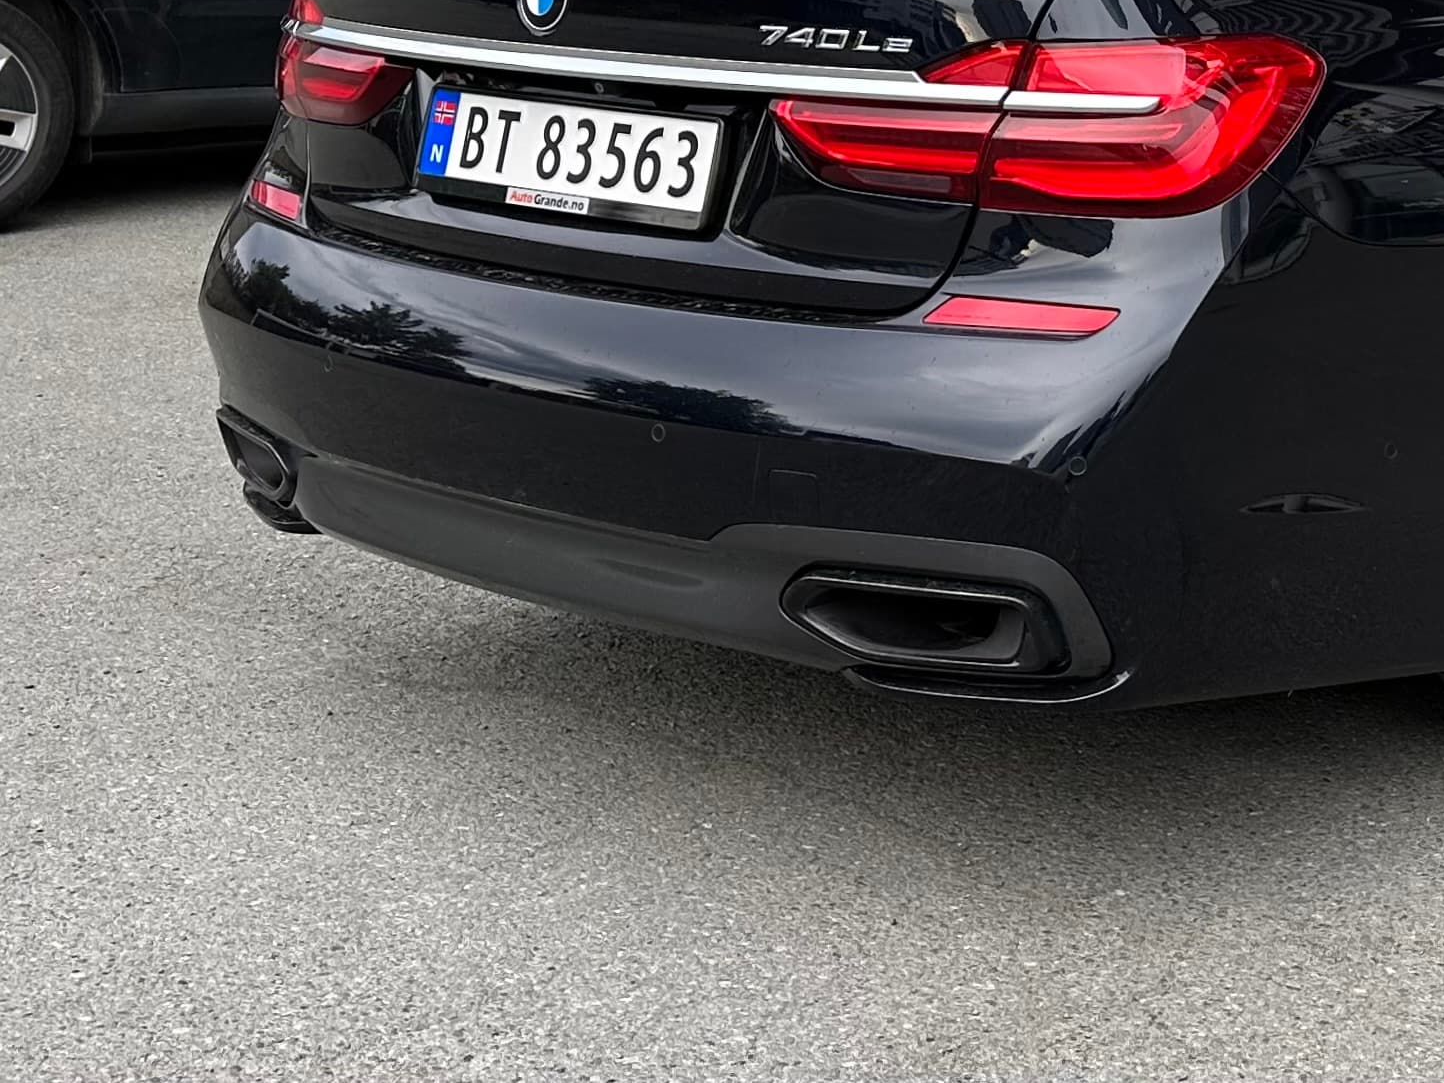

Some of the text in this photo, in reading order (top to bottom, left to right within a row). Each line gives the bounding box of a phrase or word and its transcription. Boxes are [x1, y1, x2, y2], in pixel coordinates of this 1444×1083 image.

[430, 144, 443, 163] N
[459, 106, 699, 198] BT 83563
